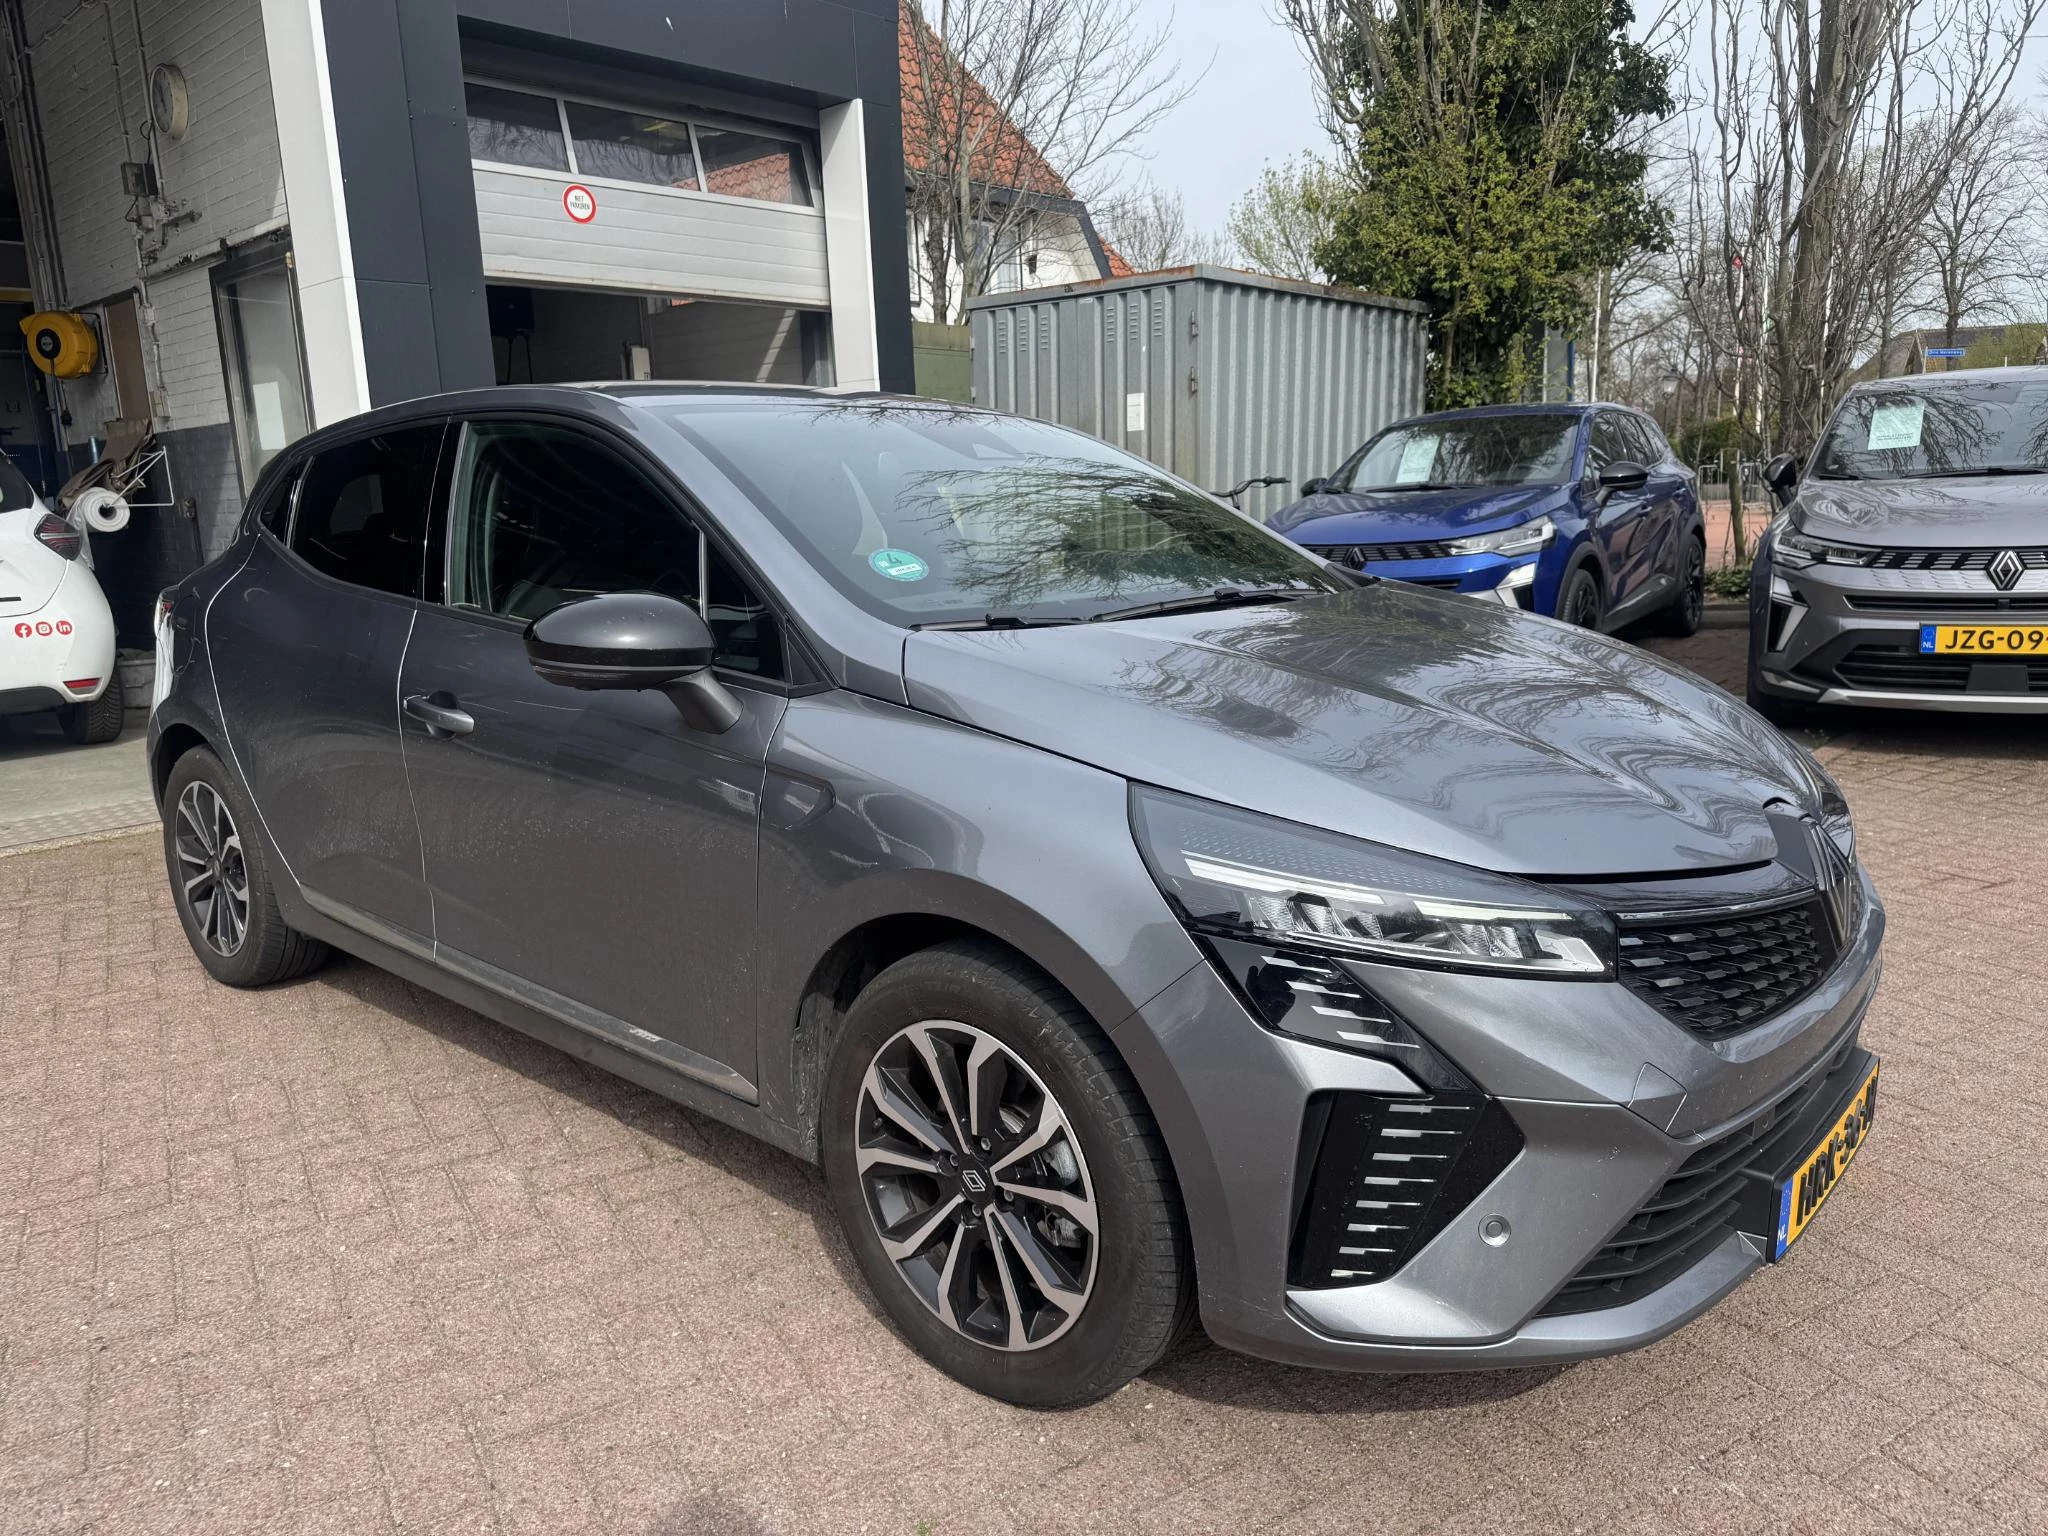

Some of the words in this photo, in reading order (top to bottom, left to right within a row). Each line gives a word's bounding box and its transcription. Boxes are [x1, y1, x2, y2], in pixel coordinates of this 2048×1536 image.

[887, 553, 902, 564] 4
[1922, 641, 1934, 649] NL
[1945, 630, 2048, 650] JZG-09
[1777, 1228, 1787, 1244] NL
